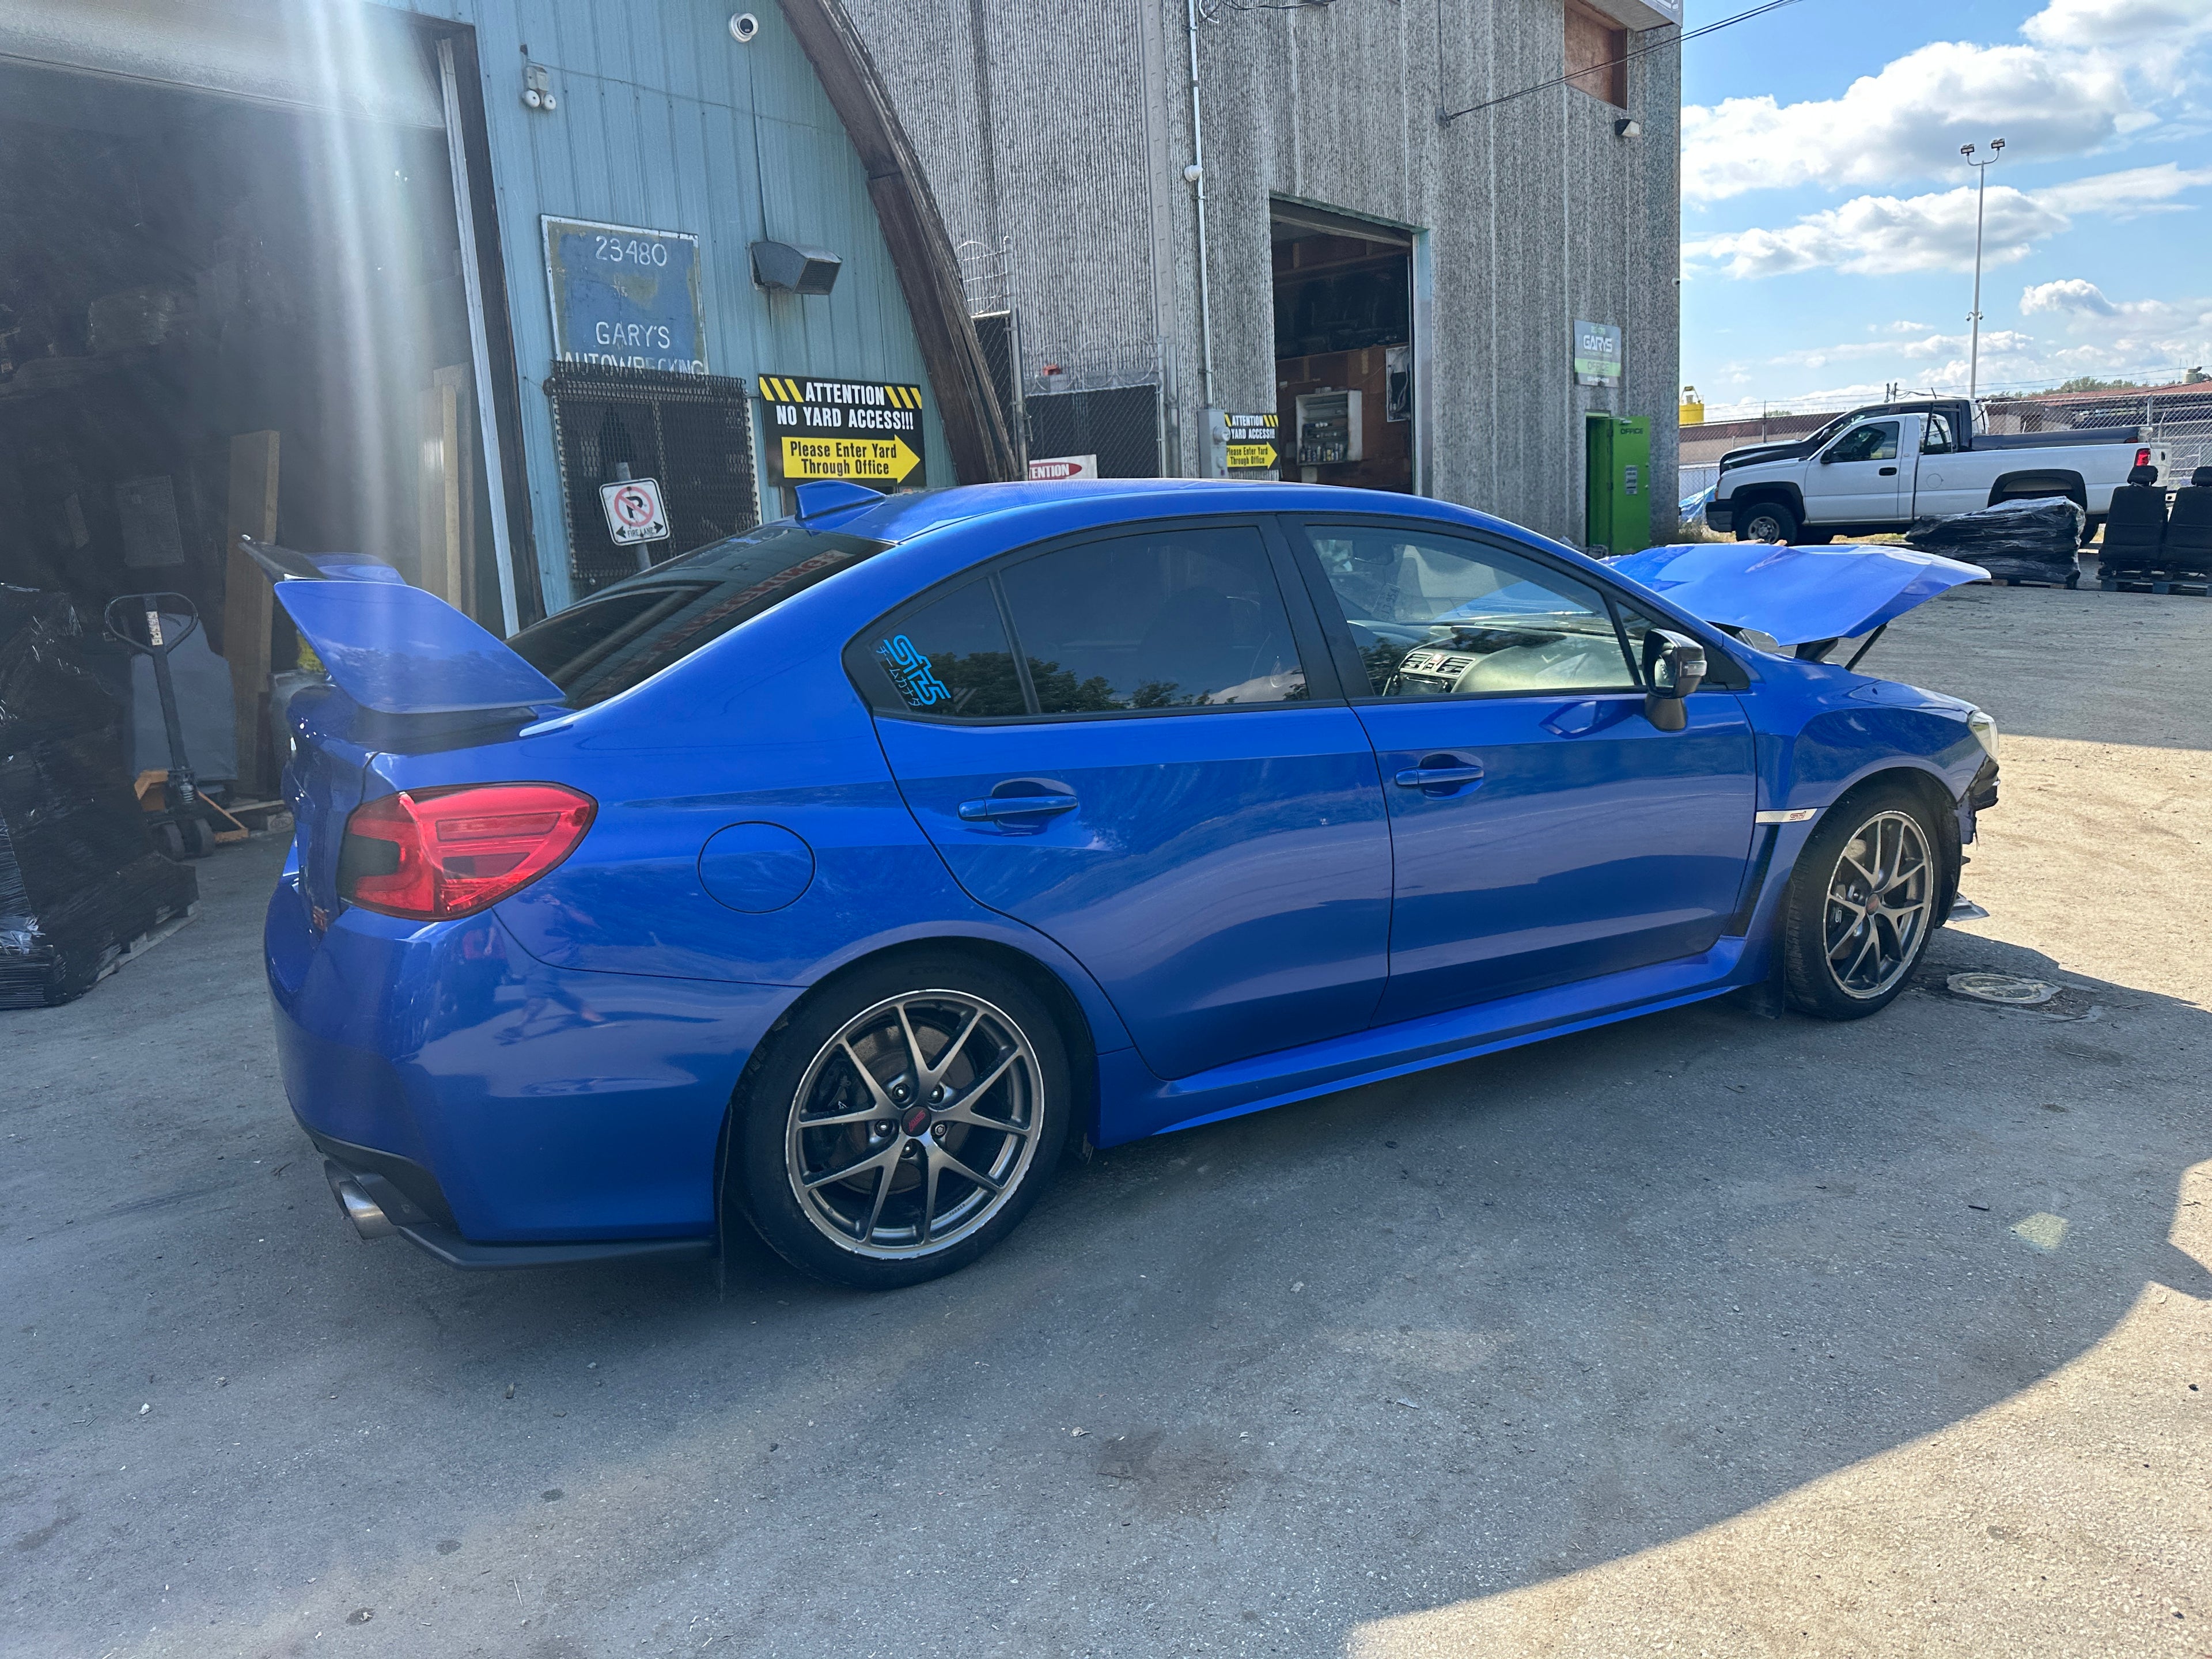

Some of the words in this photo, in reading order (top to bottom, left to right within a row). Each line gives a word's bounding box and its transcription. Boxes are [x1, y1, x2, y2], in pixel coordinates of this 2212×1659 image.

[595, 236, 668, 267] 23480
[596, 321, 671, 349] GARY'S
[1584, 335, 1612, 353] GARYS
[1588, 361, 1609, 372] OFFICE
[805, 382, 885, 406] ATTENTION
[776, 405, 797, 425] NO
[803, 407, 842, 427] YARD
[849, 409, 914, 430] ACCESS!!!
[1232, 415, 1263, 426] ATTENTION
[1231, 428, 1247, 439] YARD
[1248, 428, 1275, 439] ACCESS!!!
[790, 441, 830, 457] Please
[836, 442, 866, 458] Enter
[872, 443, 897, 458] Yard
[1226, 446, 1241, 456] Please
[1244, 446, 1256, 455] Enter
[1257, 446, 1268, 455] Yard
[801, 459, 850, 476] Through
[855, 460, 889, 475] Office
[1230, 456, 1249, 465] Through
[1251, 456, 1264, 464] Office
[627, 529, 641, 538] FIRE
[639, 527, 656, 537] LANE
[876, 646, 923, 706] チームカナダ
